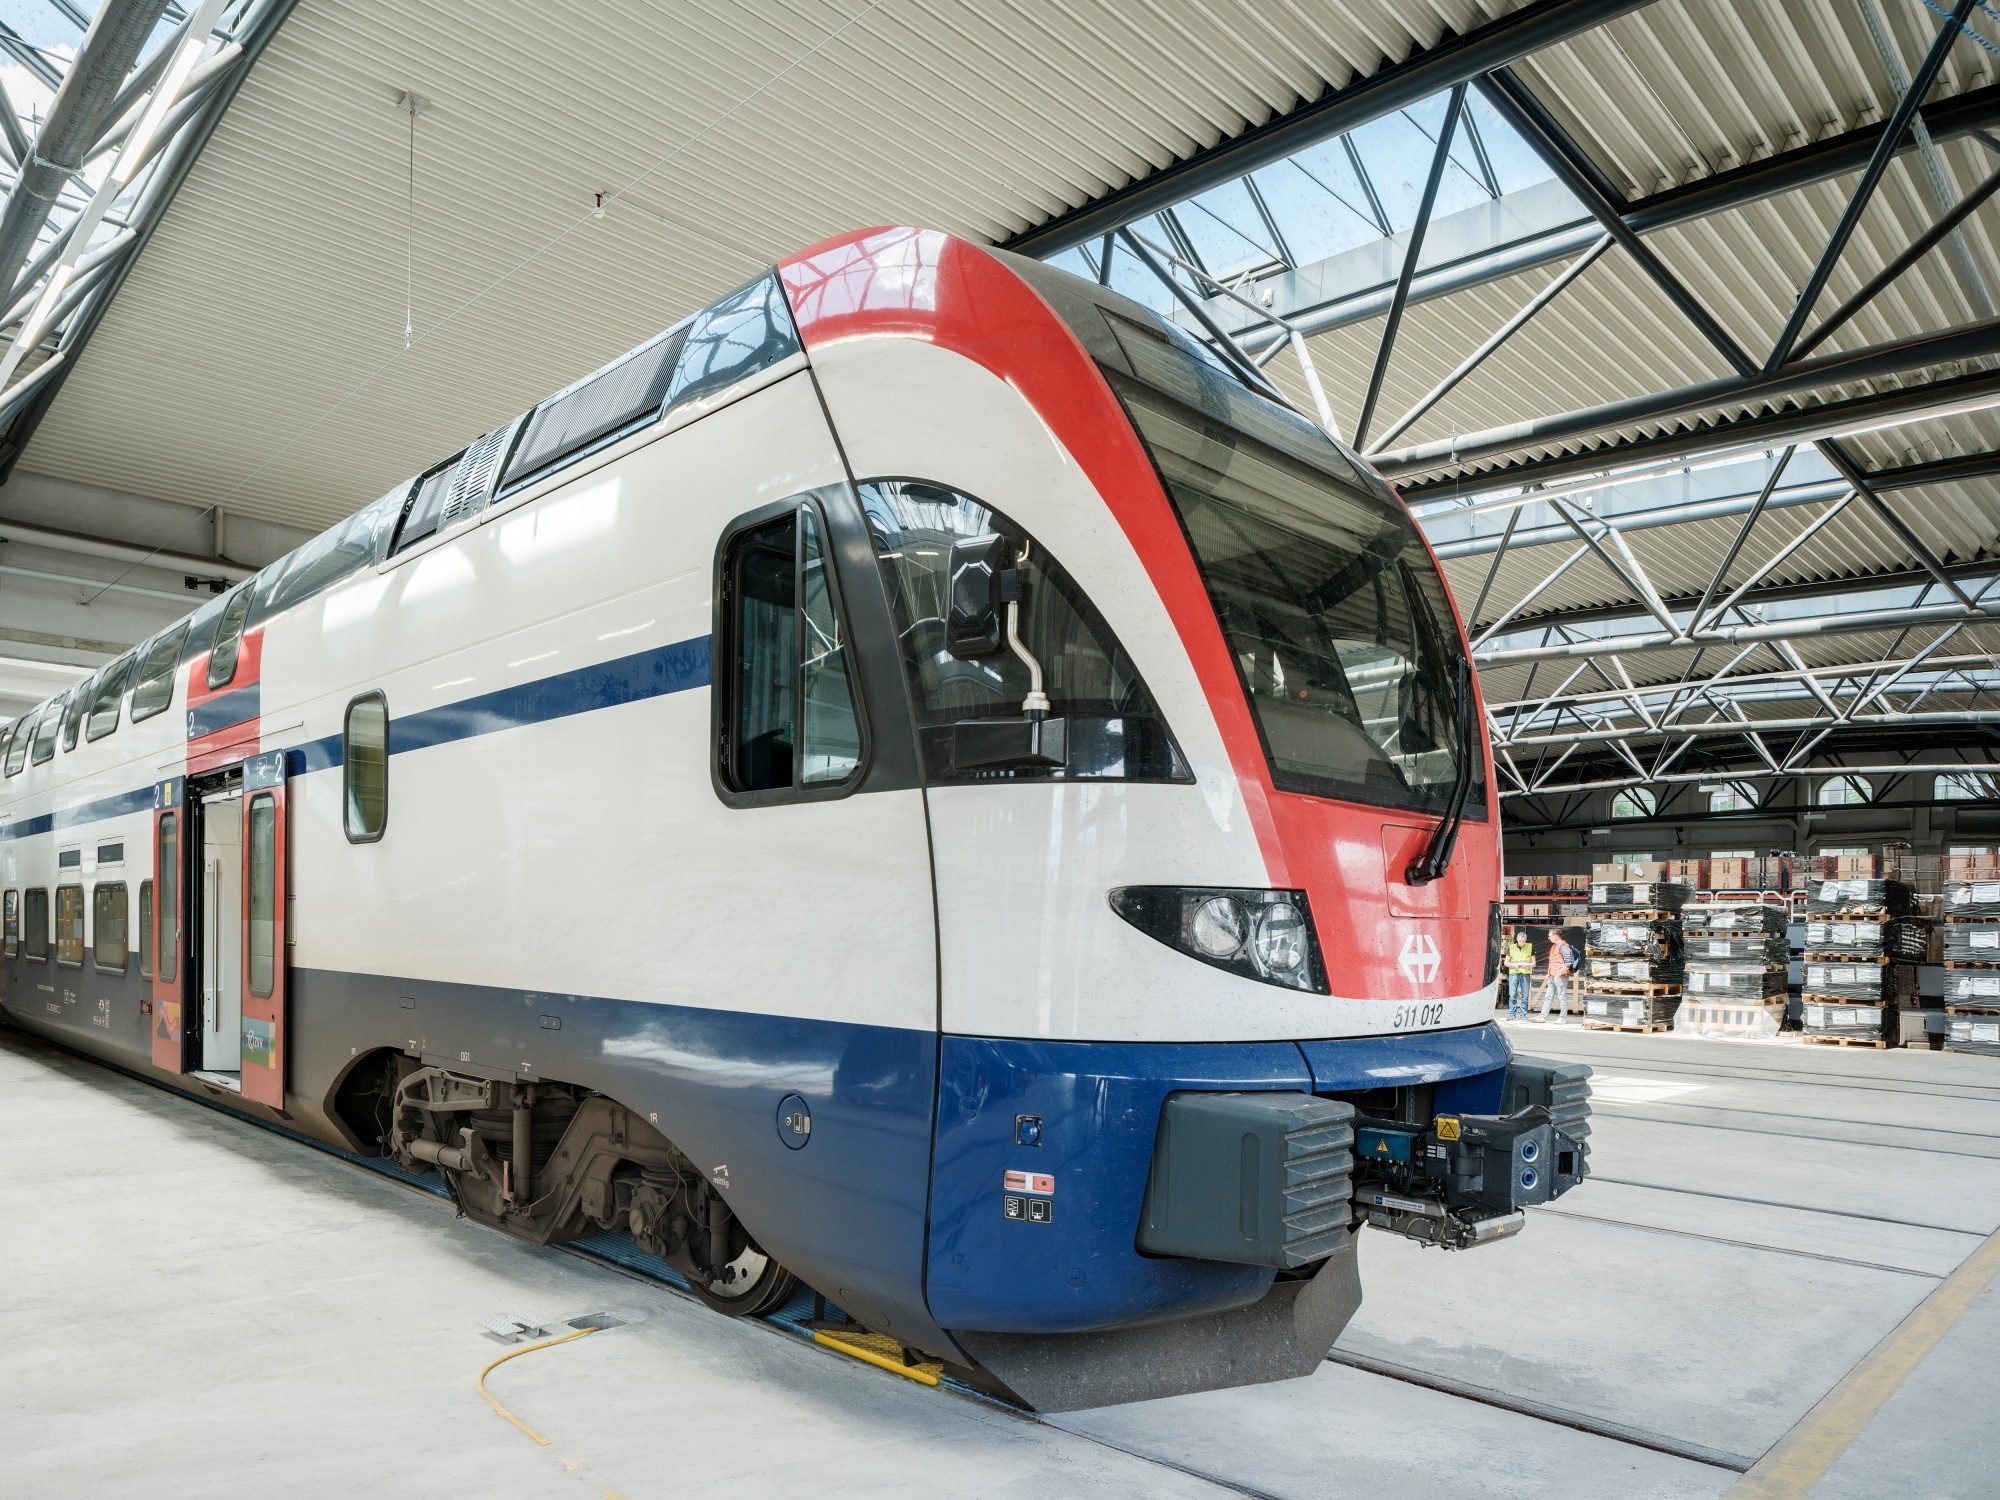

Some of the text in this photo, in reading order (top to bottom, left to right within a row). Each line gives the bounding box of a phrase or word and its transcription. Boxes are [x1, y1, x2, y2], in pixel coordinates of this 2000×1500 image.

[188, 711, 195, 736] 2
[275, 752, 283, 783] 2
[154, 785, 160, 809] 2
[1393, 1003, 1444, 1028] 511 012
[460, 1051, 471, 1063] DG1
[649, 1112, 658, 1123] 1R
[712, 1176, 730, 1189] mittig
